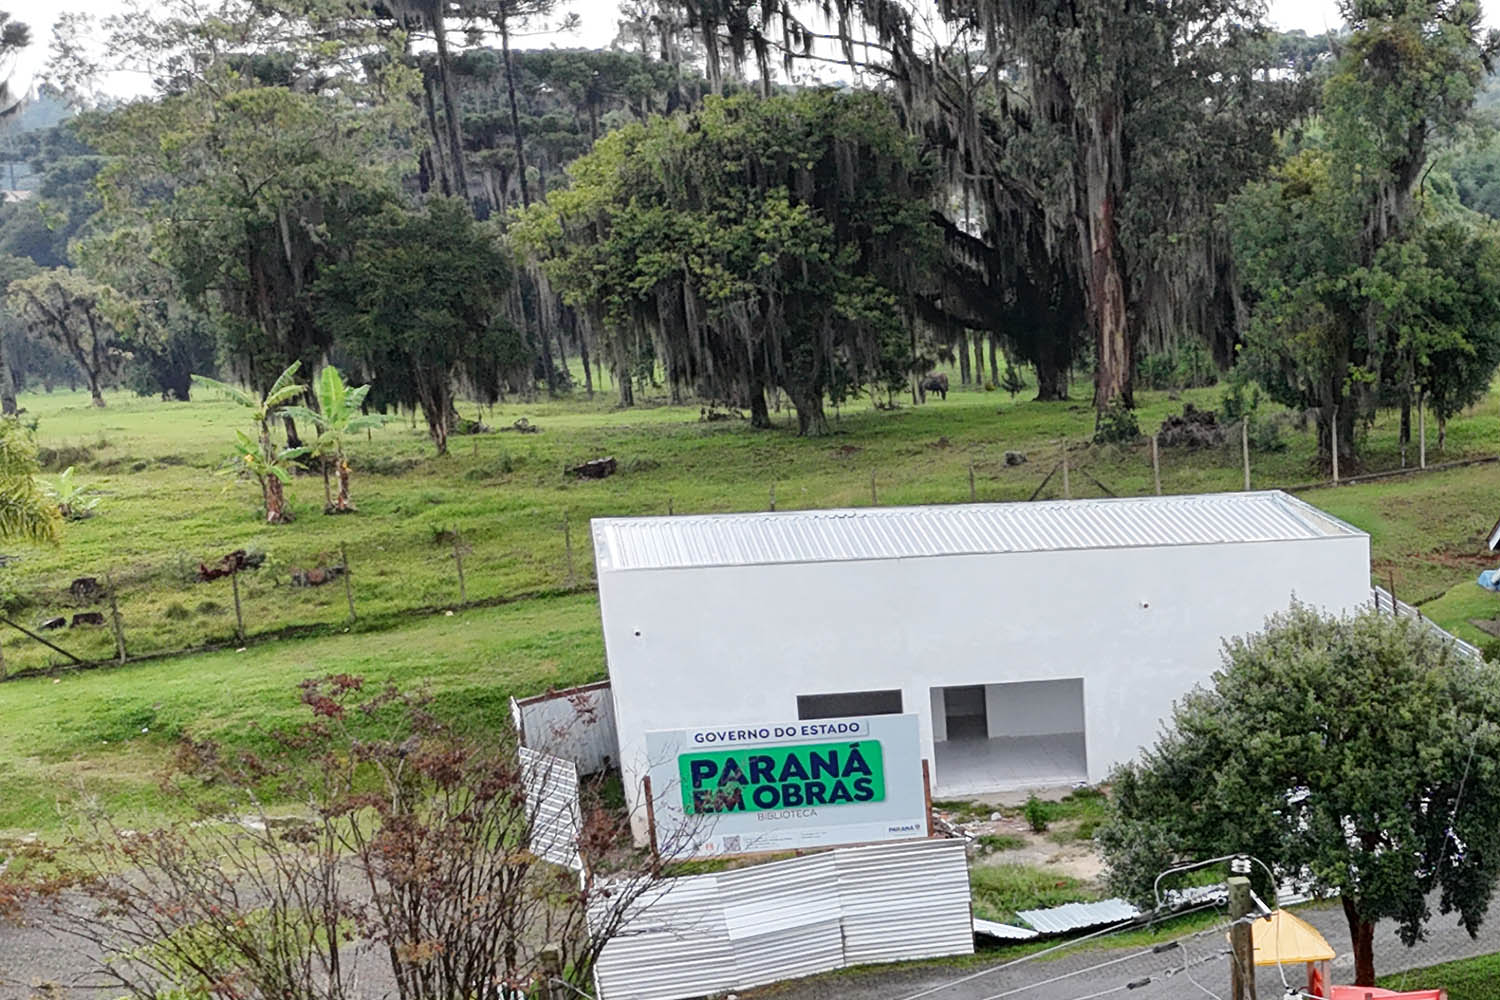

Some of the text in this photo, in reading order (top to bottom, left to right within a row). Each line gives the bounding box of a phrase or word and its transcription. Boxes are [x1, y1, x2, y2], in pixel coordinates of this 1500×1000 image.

[694, 722, 860, 743] GOVERNO DO ESTADO
[690, 742, 872, 788] PARANÁ
[693, 777, 875, 814] EM OBRAS
[757, 808, 818, 821] BIBLIOTECA
